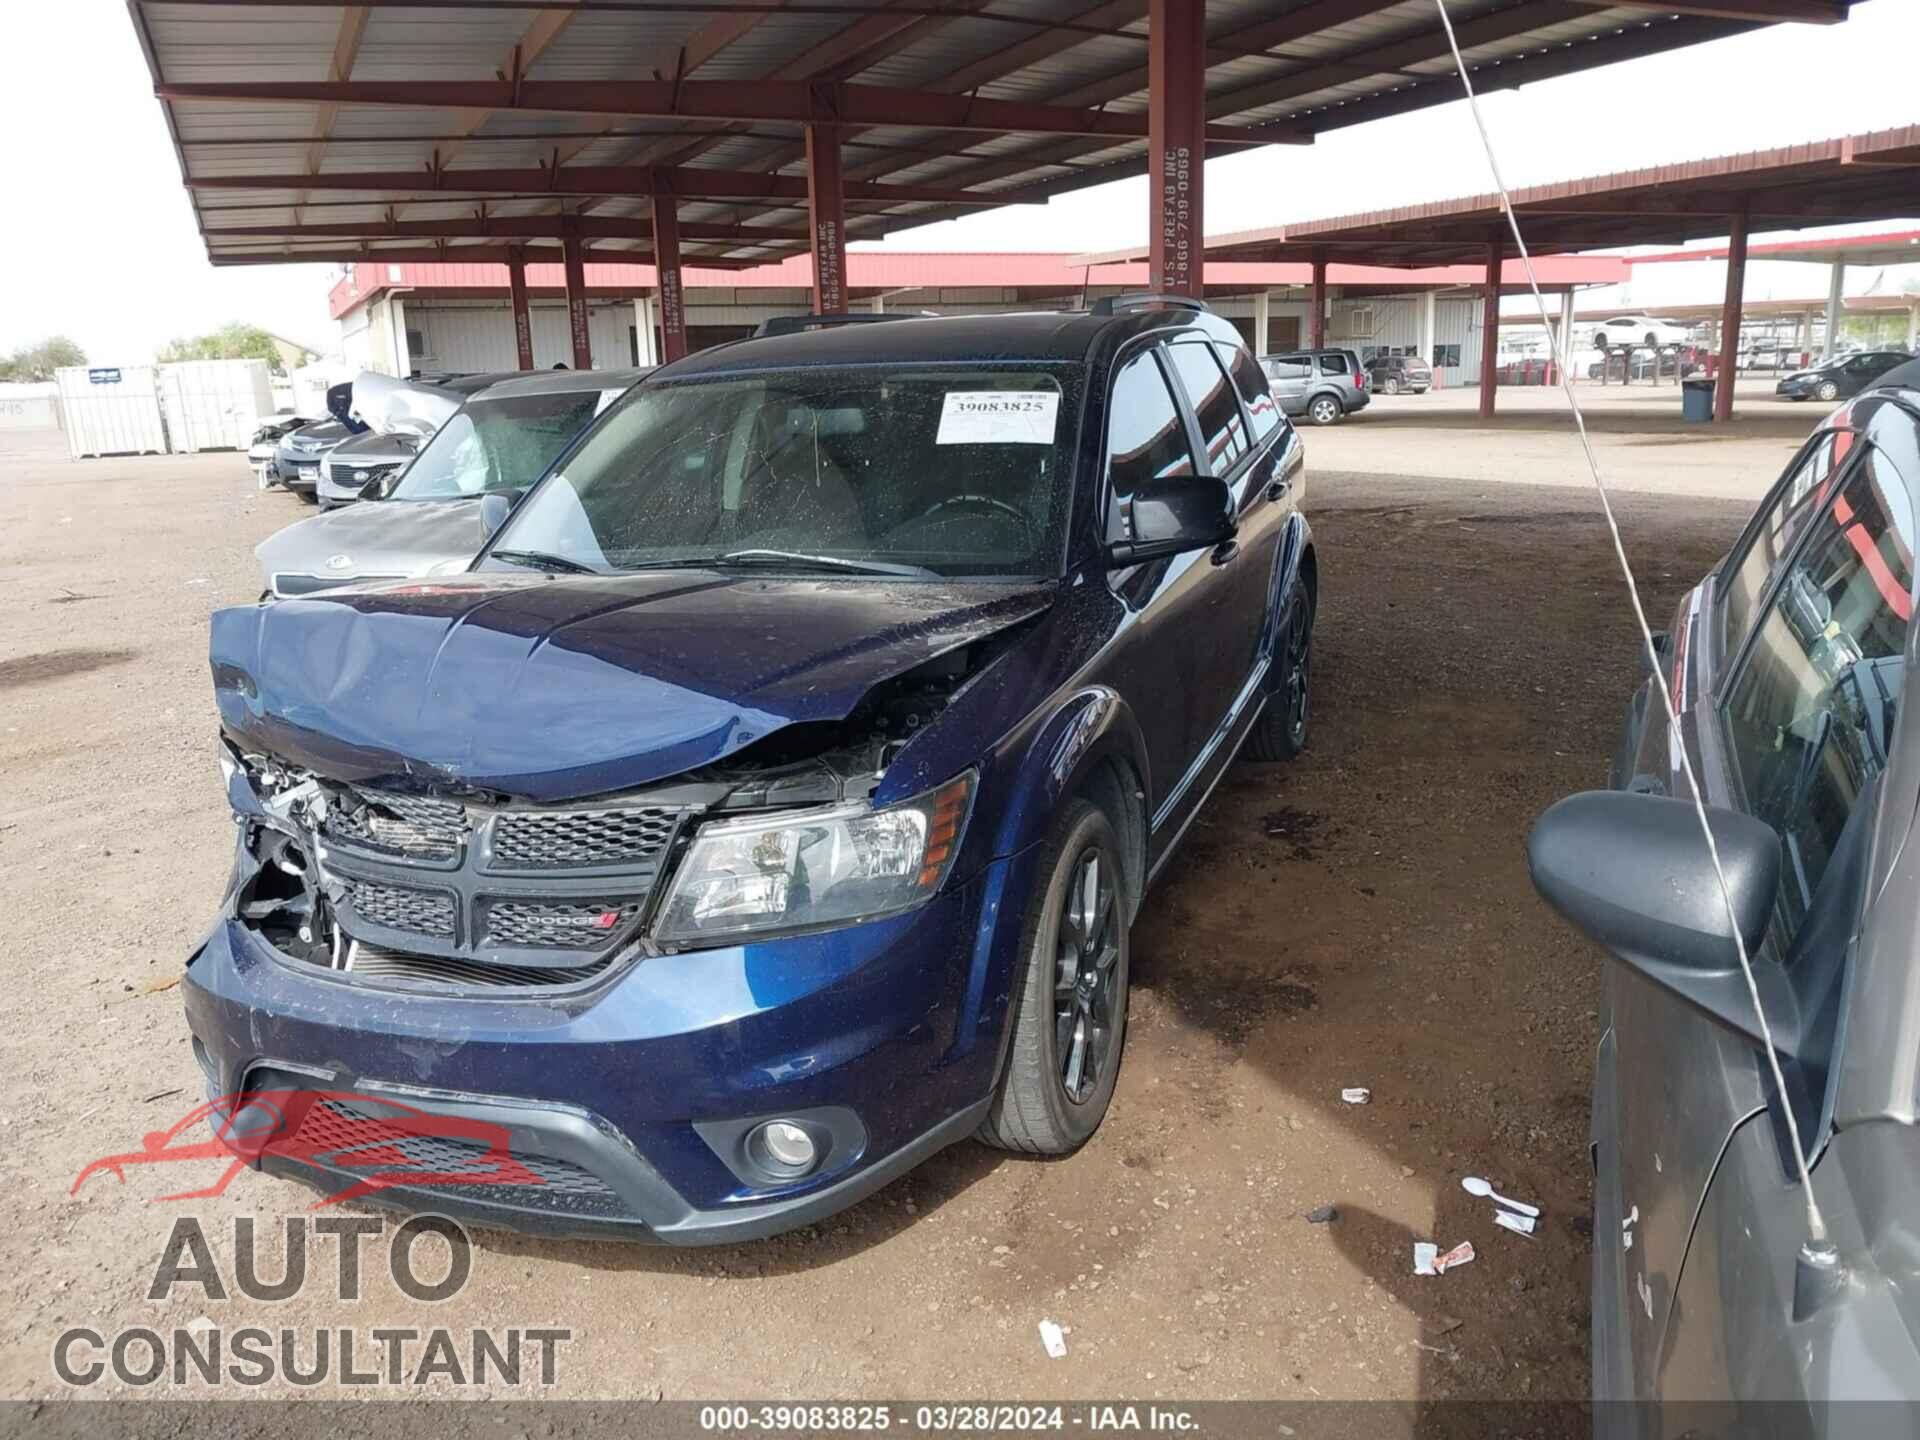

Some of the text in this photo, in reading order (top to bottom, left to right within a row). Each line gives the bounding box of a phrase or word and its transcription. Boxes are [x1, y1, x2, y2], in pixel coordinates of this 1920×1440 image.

[1164, 185, 1176, 247] PREFAB
[1177, 147, 1190, 286] 1-866-799-0969
[954, 401, 1044, 413] 39083825
